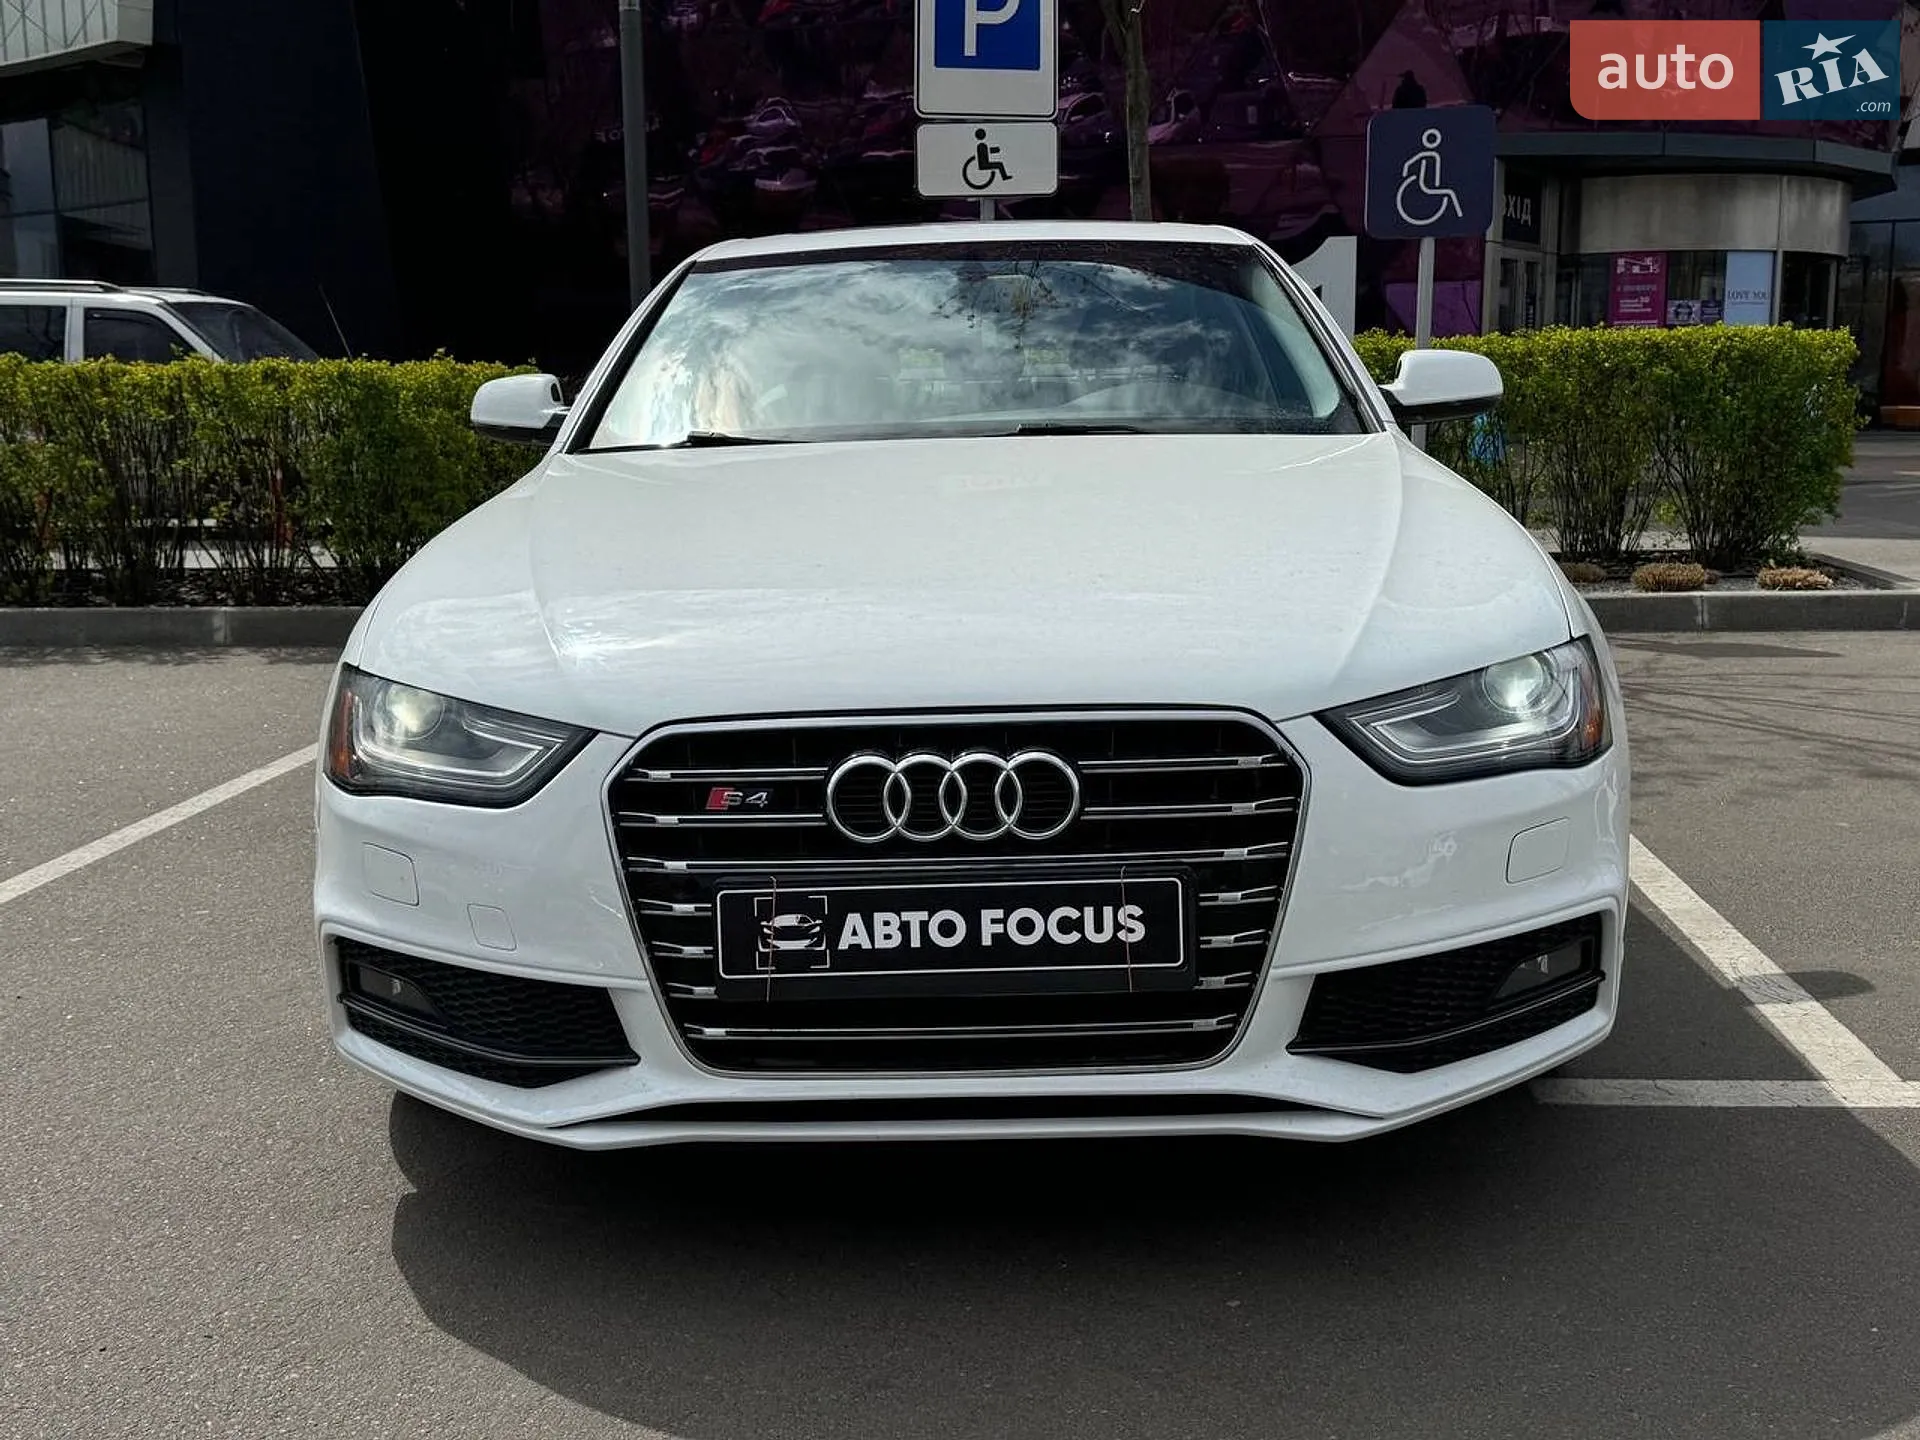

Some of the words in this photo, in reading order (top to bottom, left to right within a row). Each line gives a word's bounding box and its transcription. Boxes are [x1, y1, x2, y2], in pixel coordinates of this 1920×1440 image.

[964, 0, 1020, 57] P
[716, 789, 769, 810] S4
[837, 908, 967, 950] АВТО
[980, 904, 1146, 947] FOCUS
